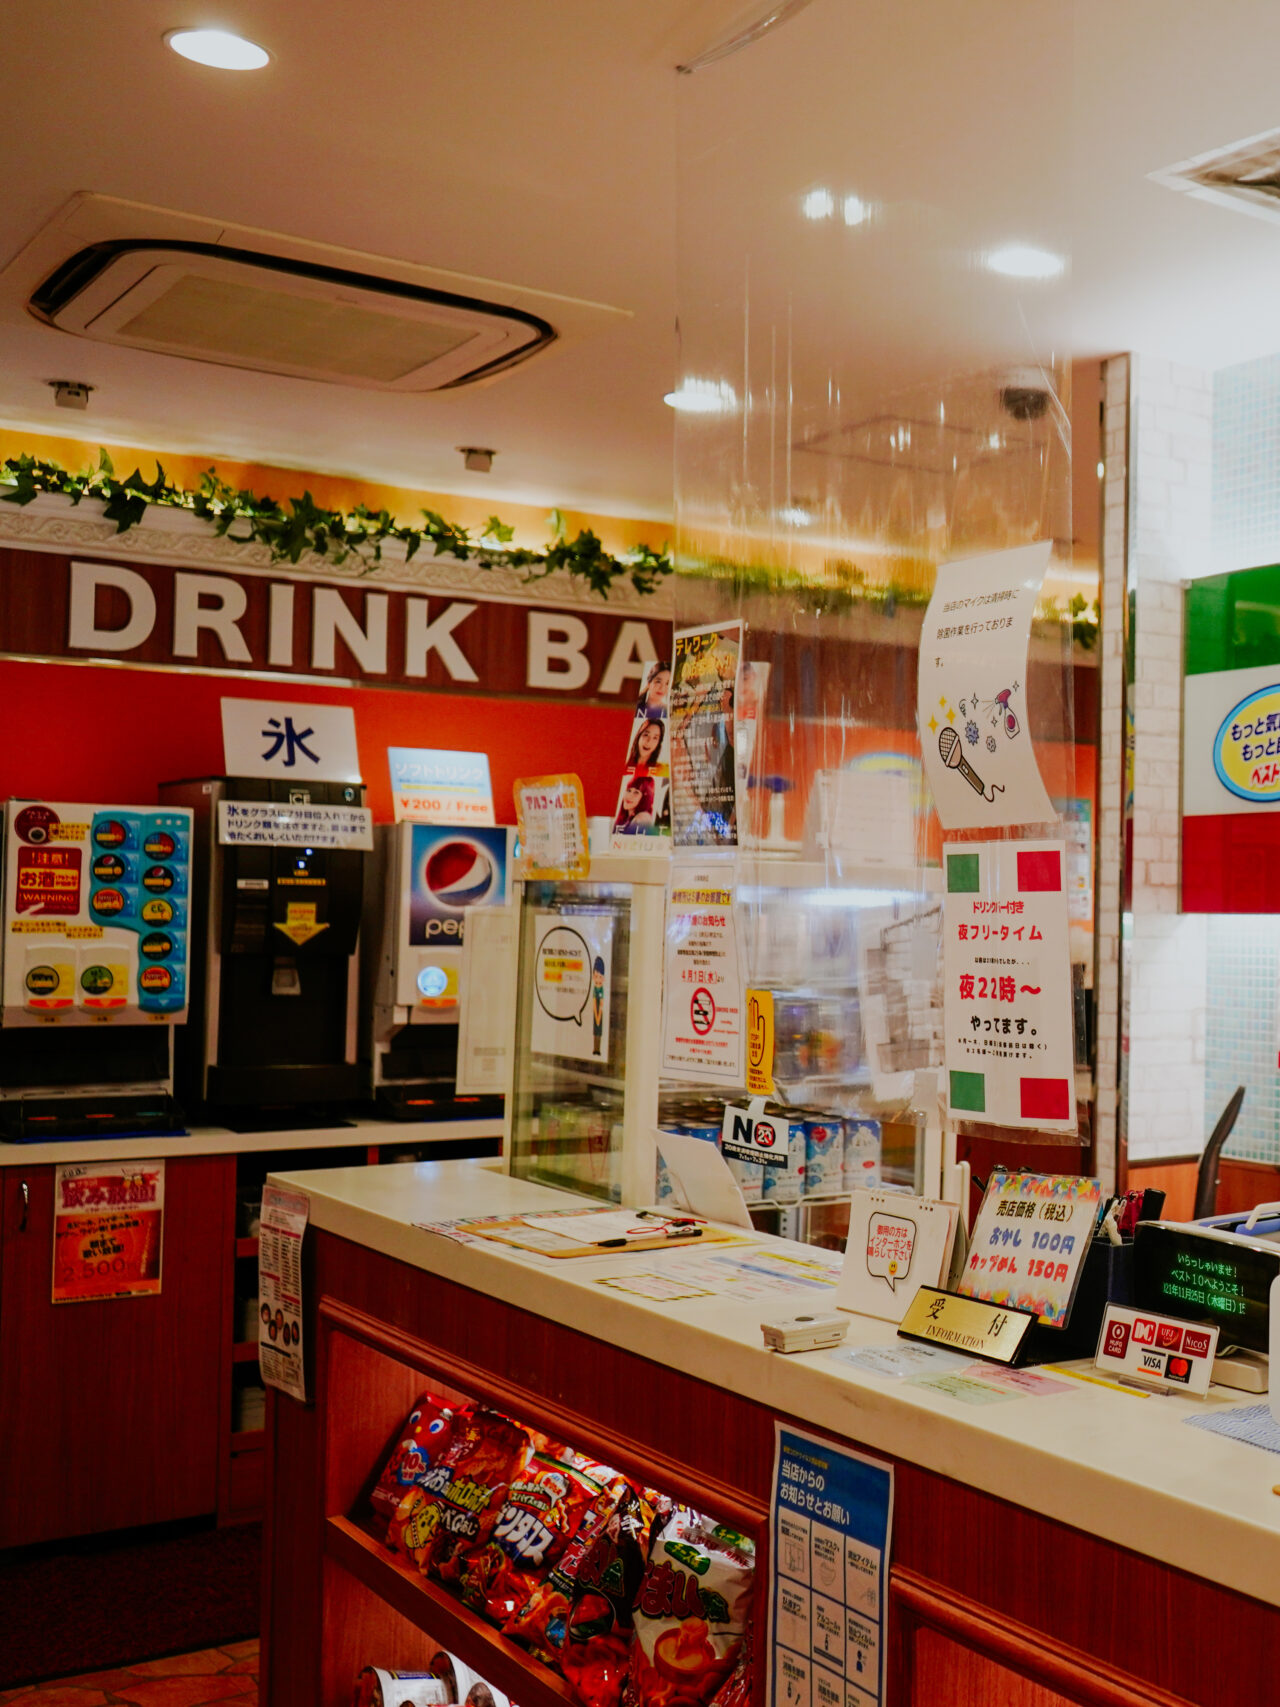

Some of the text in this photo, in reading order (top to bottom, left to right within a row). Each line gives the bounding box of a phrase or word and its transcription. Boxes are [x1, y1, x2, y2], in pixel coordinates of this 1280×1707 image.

[68, 560, 480, 683] DRINK
[676, 632, 718, 656] テレワーク
[261, 717, 321, 767] 氷
[457, 800, 489, 813] Free
[972, 901, 1025, 915] ドリンクバー付き
[957, 923, 1043, 941] 夜フリータイム
[958, 973, 1042, 1003] 夜22時～
[970, 1015, 1037, 1036] やってます。
[989, 1226, 1076, 1255] おかし 100円
[969, 1252, 1069, 1283] カップめん 150円
[925, 1324, 985, 1349] INFORMATION
[1108, 1345, 1122, 1354] CARD
[1143, 1355, 1161, 1370] VISA
[781, 1459, 825, 1492] 当店からの
[780, 1482, 850, 1525] お知らせとお願い
